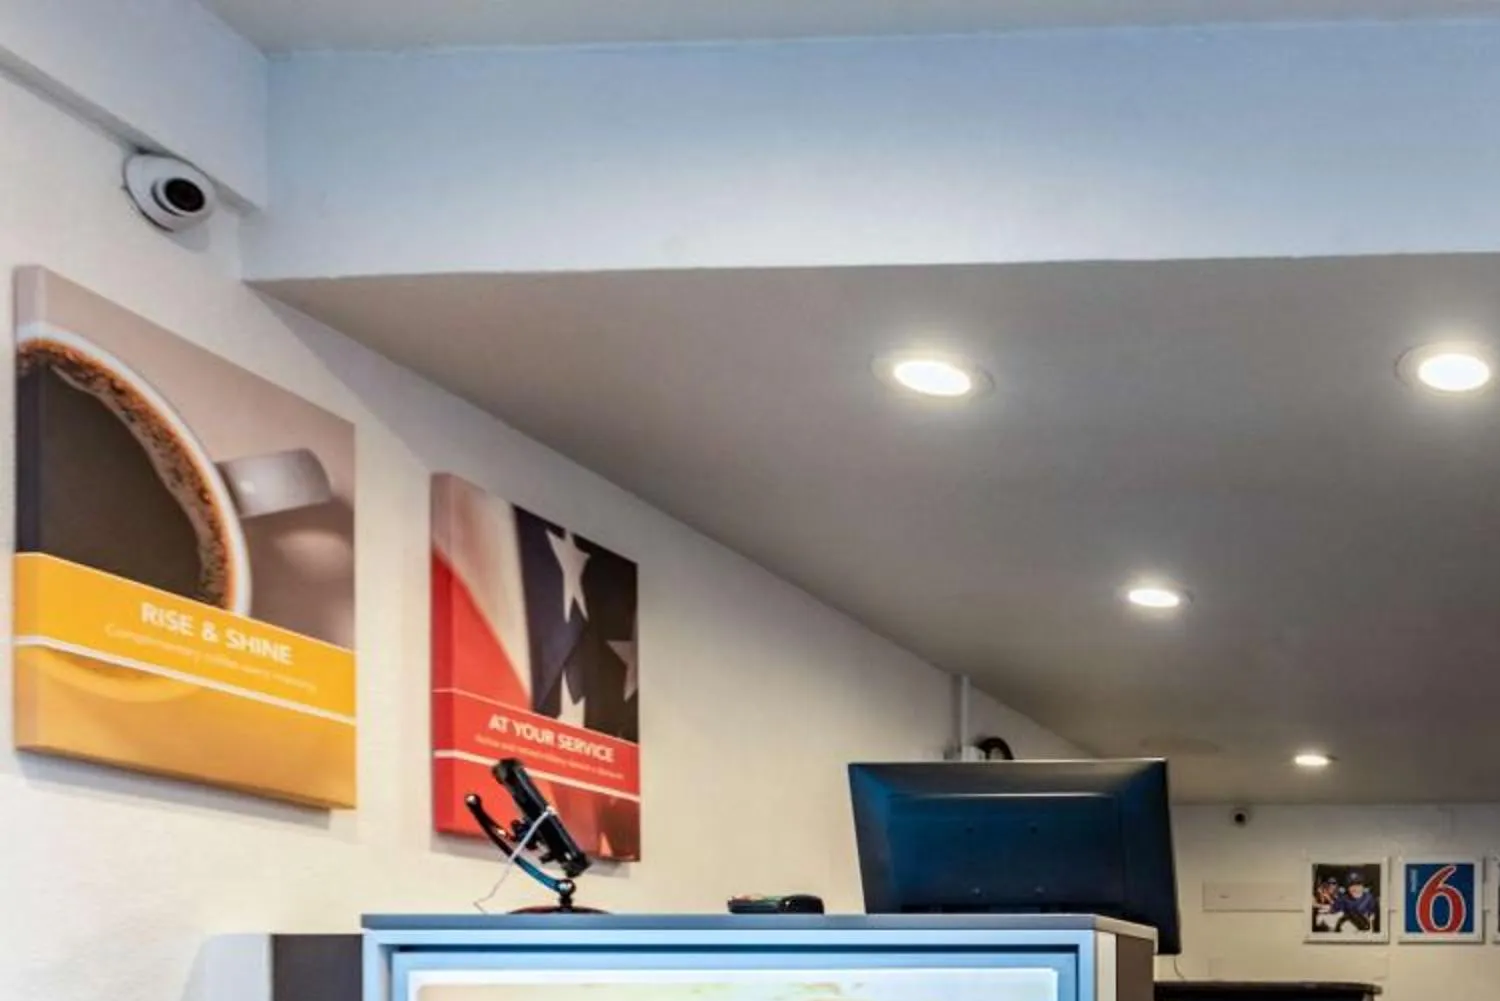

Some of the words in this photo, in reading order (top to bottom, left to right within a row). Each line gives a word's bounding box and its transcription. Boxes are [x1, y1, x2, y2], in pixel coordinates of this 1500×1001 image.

[140, 602, 195, 638] RISE
[201, 619, 220, 644] &
[225, 627, 295, 666] SHINE
[488, 713, 510, 733] AT
[511, 719, 555, 748] YOUR
[556, 731, 616, 763] SERVICE
[1416, 864, 1467, 935] 6
